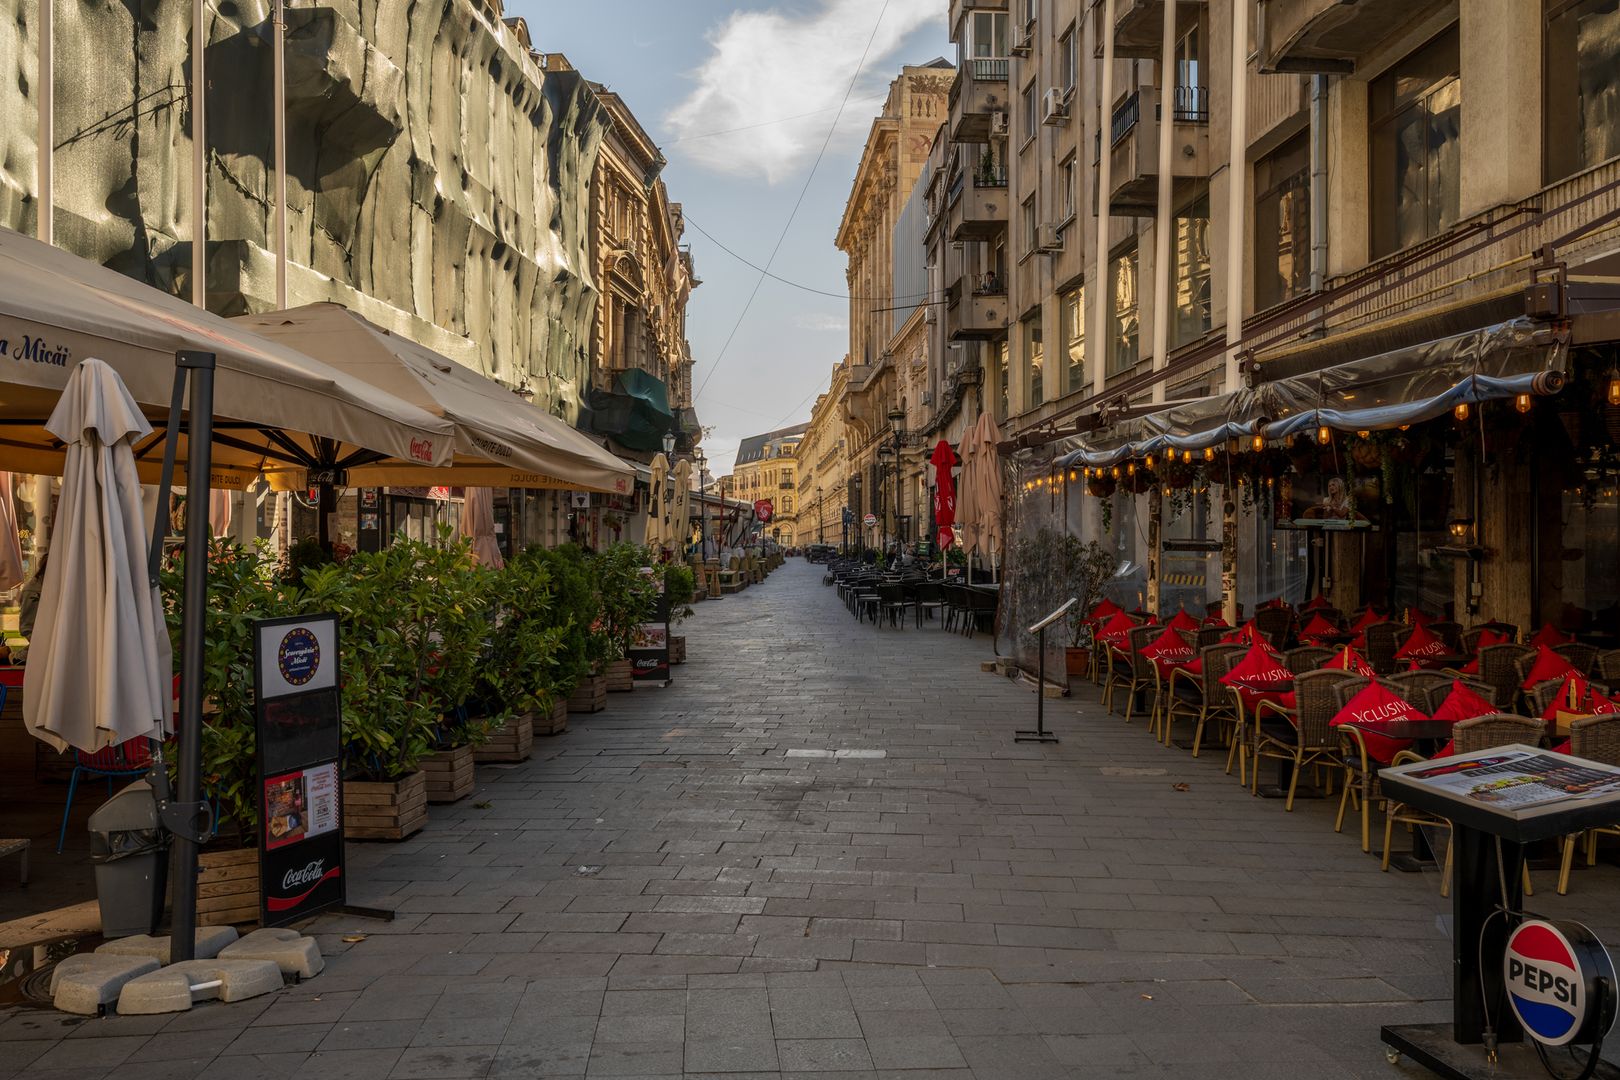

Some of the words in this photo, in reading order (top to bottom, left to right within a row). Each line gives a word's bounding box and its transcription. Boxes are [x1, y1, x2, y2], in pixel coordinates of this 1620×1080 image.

[13, 335, 67, 367] Micăi
[282, 858, 325, 889] Coca-Cola
[1509, 957, 1577, 1007] PEPSI
